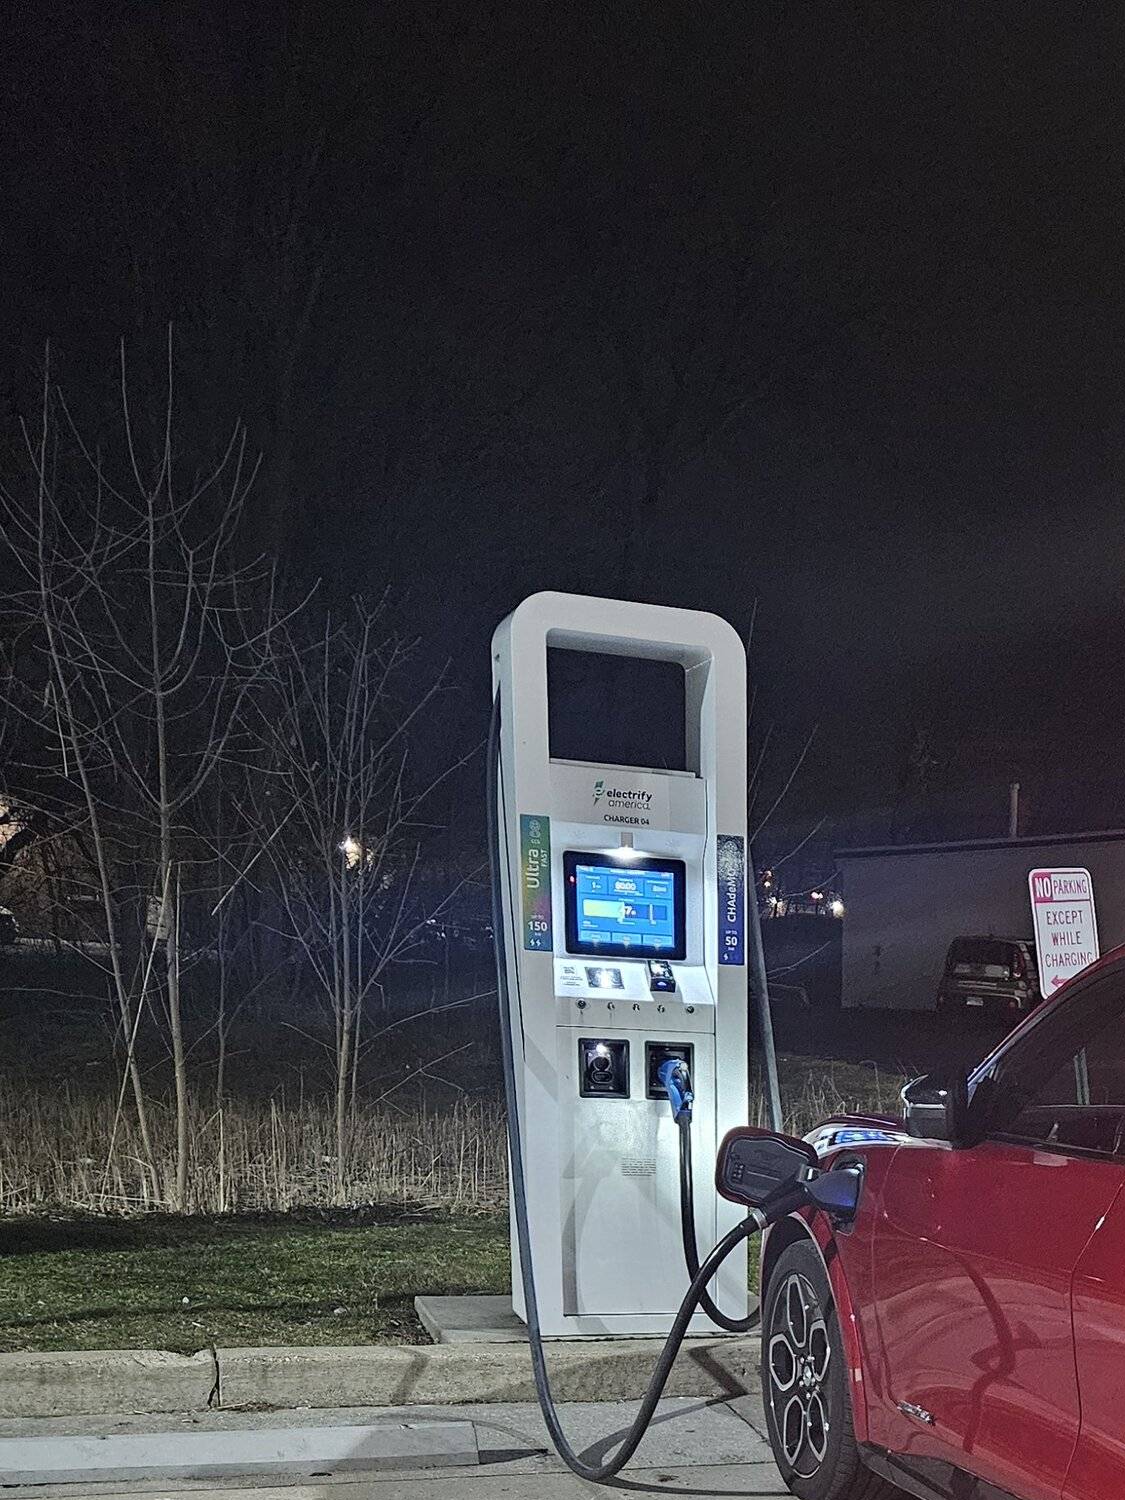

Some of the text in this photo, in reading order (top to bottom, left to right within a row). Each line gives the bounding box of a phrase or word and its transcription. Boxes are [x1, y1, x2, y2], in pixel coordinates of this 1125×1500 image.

[606, 788, 652, 802] electrify
[603, 814, 650, 826] CHARGER 04
[540, 848, 548, 868] FAST
[525, 849, 540, 889] Ultra
[1034, 876, 1087, 898] NO PARKING
[726, 868, 737, 923] CHAdeMO
[1046, 910, 1083, 926] EXCEPT
[527, 921, 548, 932] 150
[725, 936, 738, 946] 50
[1051, 930, 1083, 946] WHILE
[1045, 951, 1093, 968] CHARGING
